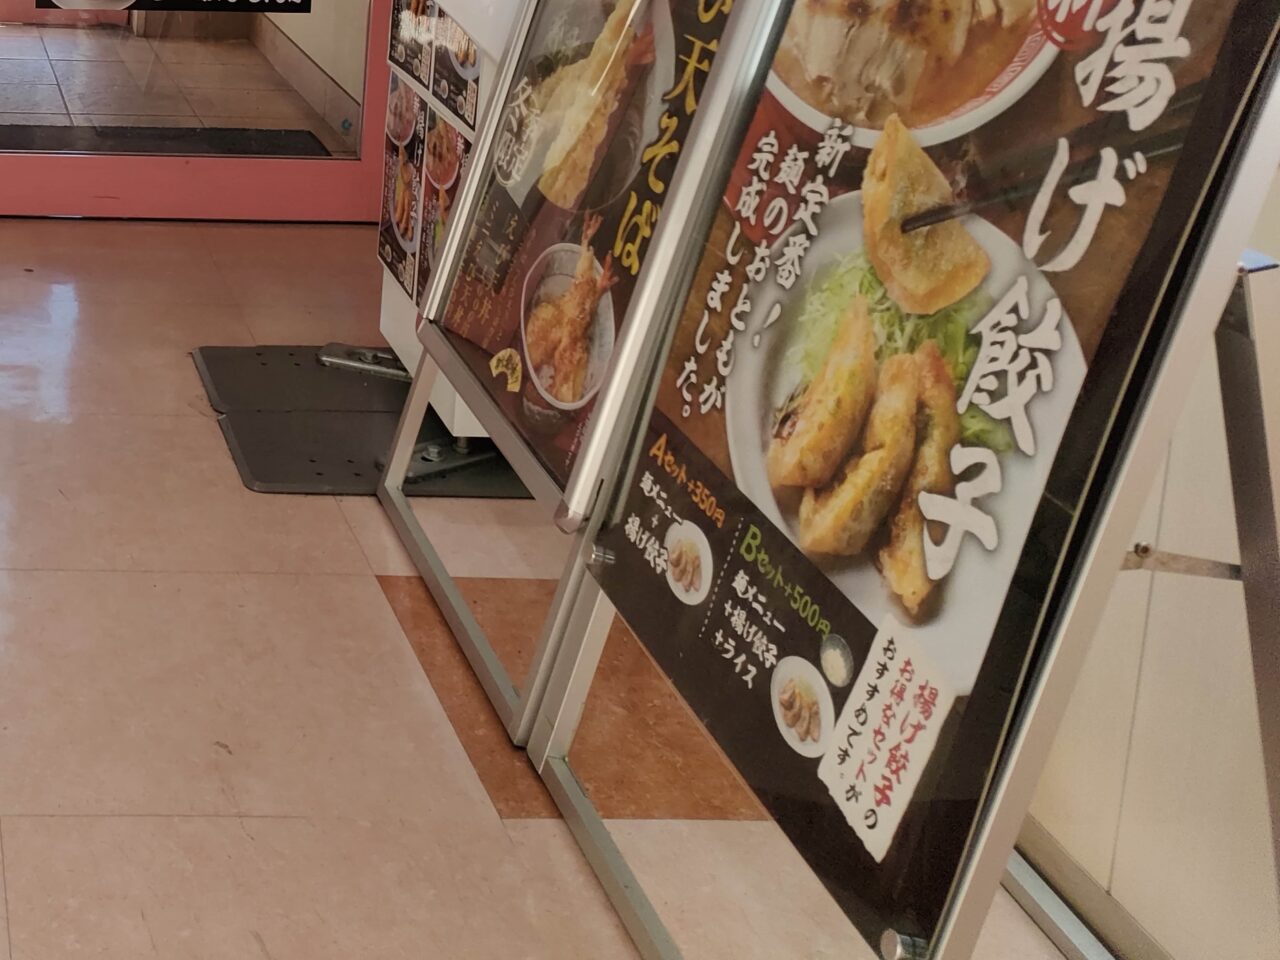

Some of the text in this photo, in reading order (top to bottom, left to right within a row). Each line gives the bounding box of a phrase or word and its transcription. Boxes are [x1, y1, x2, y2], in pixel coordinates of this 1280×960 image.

[676, 129, 779, 418] 完成しました。
[699, 143, 810, 416] 麺のおともが
[639, 470, 683, 525] 麺メニュー
[624, 512, 669, 576] 揚げ餃子
[732, 569, 786, 632] 麺メニュー
[713, 629, 758, 690] +ライス
[864, 680, 939, 830] 揚げ餃子の
